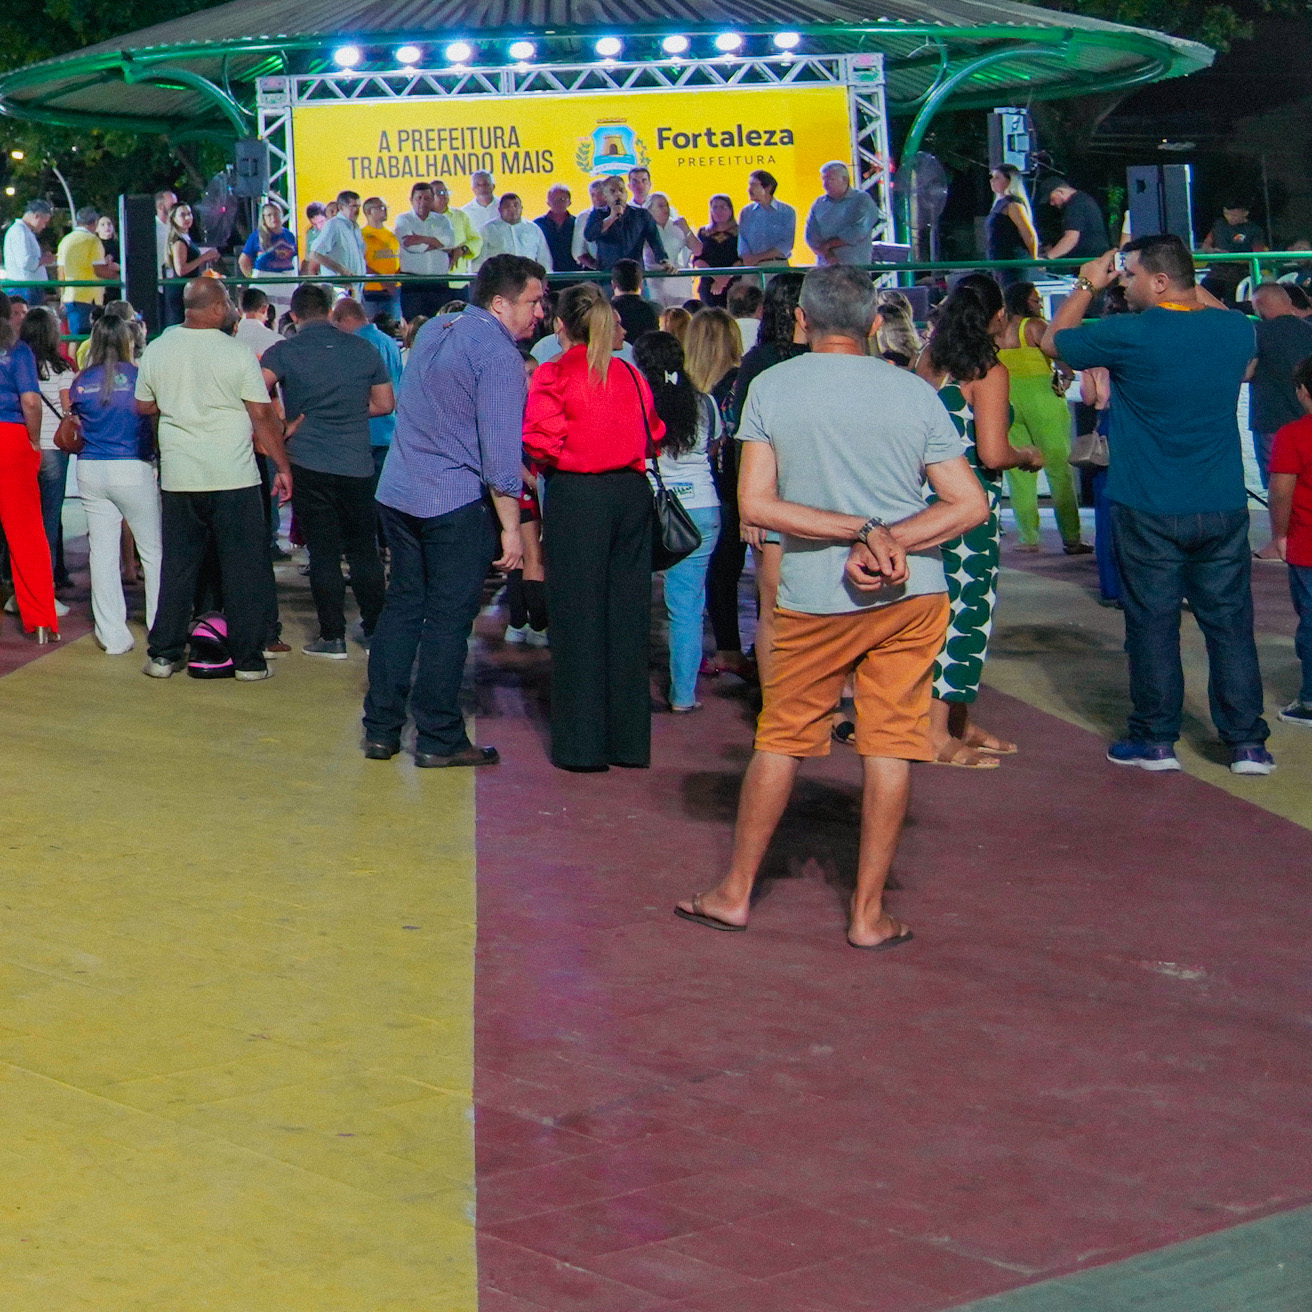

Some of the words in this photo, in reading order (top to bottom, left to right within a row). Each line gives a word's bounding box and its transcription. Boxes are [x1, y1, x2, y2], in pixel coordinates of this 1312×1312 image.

[378, 129, 391, 153] A
[397, 125, 521, 152] PREFEITURA
[657, 124, 795, 150] Fortaleza
[347, 151, 494, 180] TRABALHANDO
[501, 149, 554, 175] MAIS
[677, 154, 777, 168] PREFEITURA
